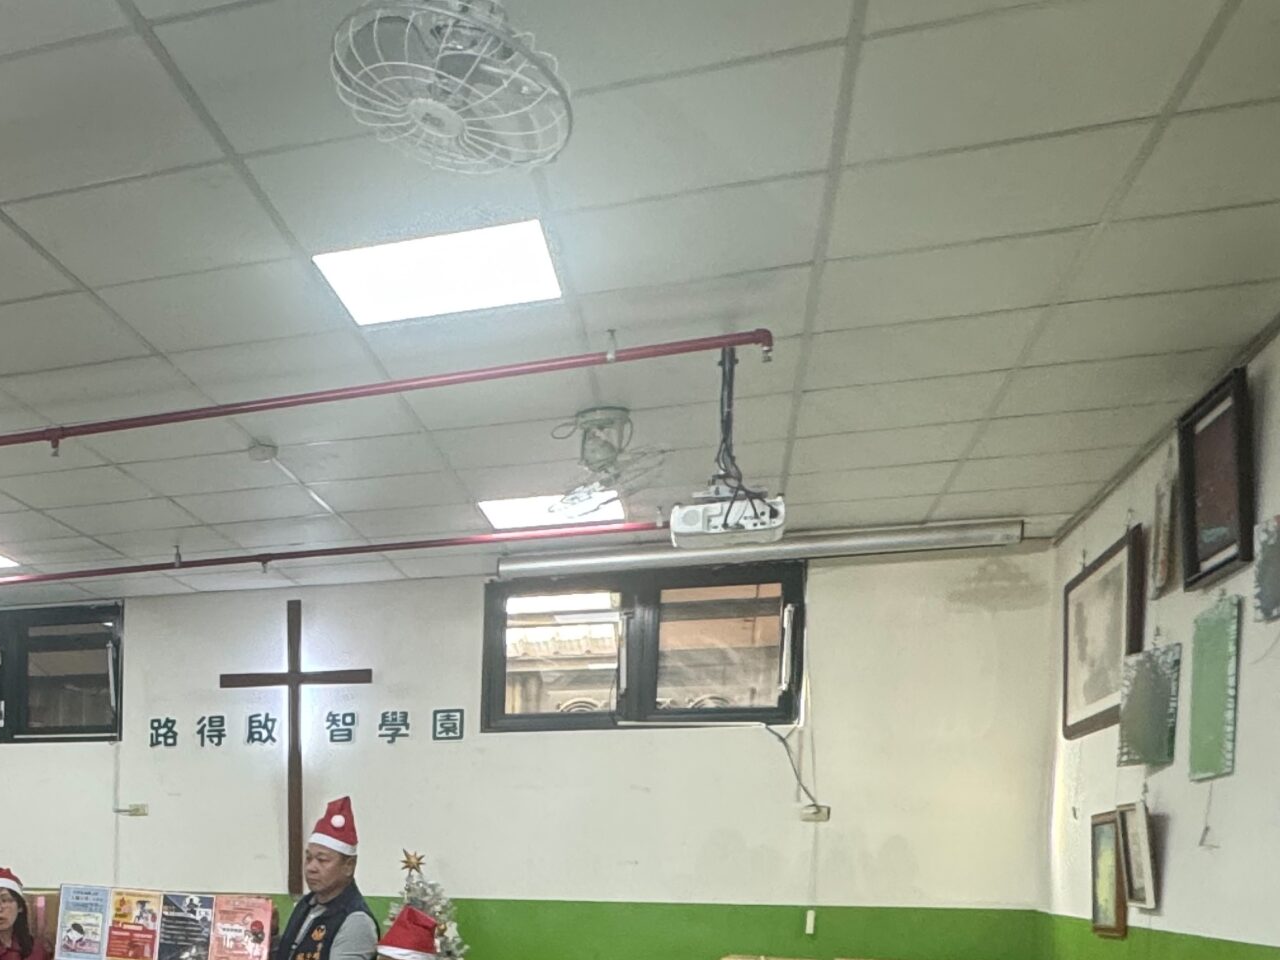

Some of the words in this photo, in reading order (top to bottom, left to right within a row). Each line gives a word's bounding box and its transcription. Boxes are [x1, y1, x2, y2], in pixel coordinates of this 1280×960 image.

[149, 708, 465, 748] 路得啟智學園
